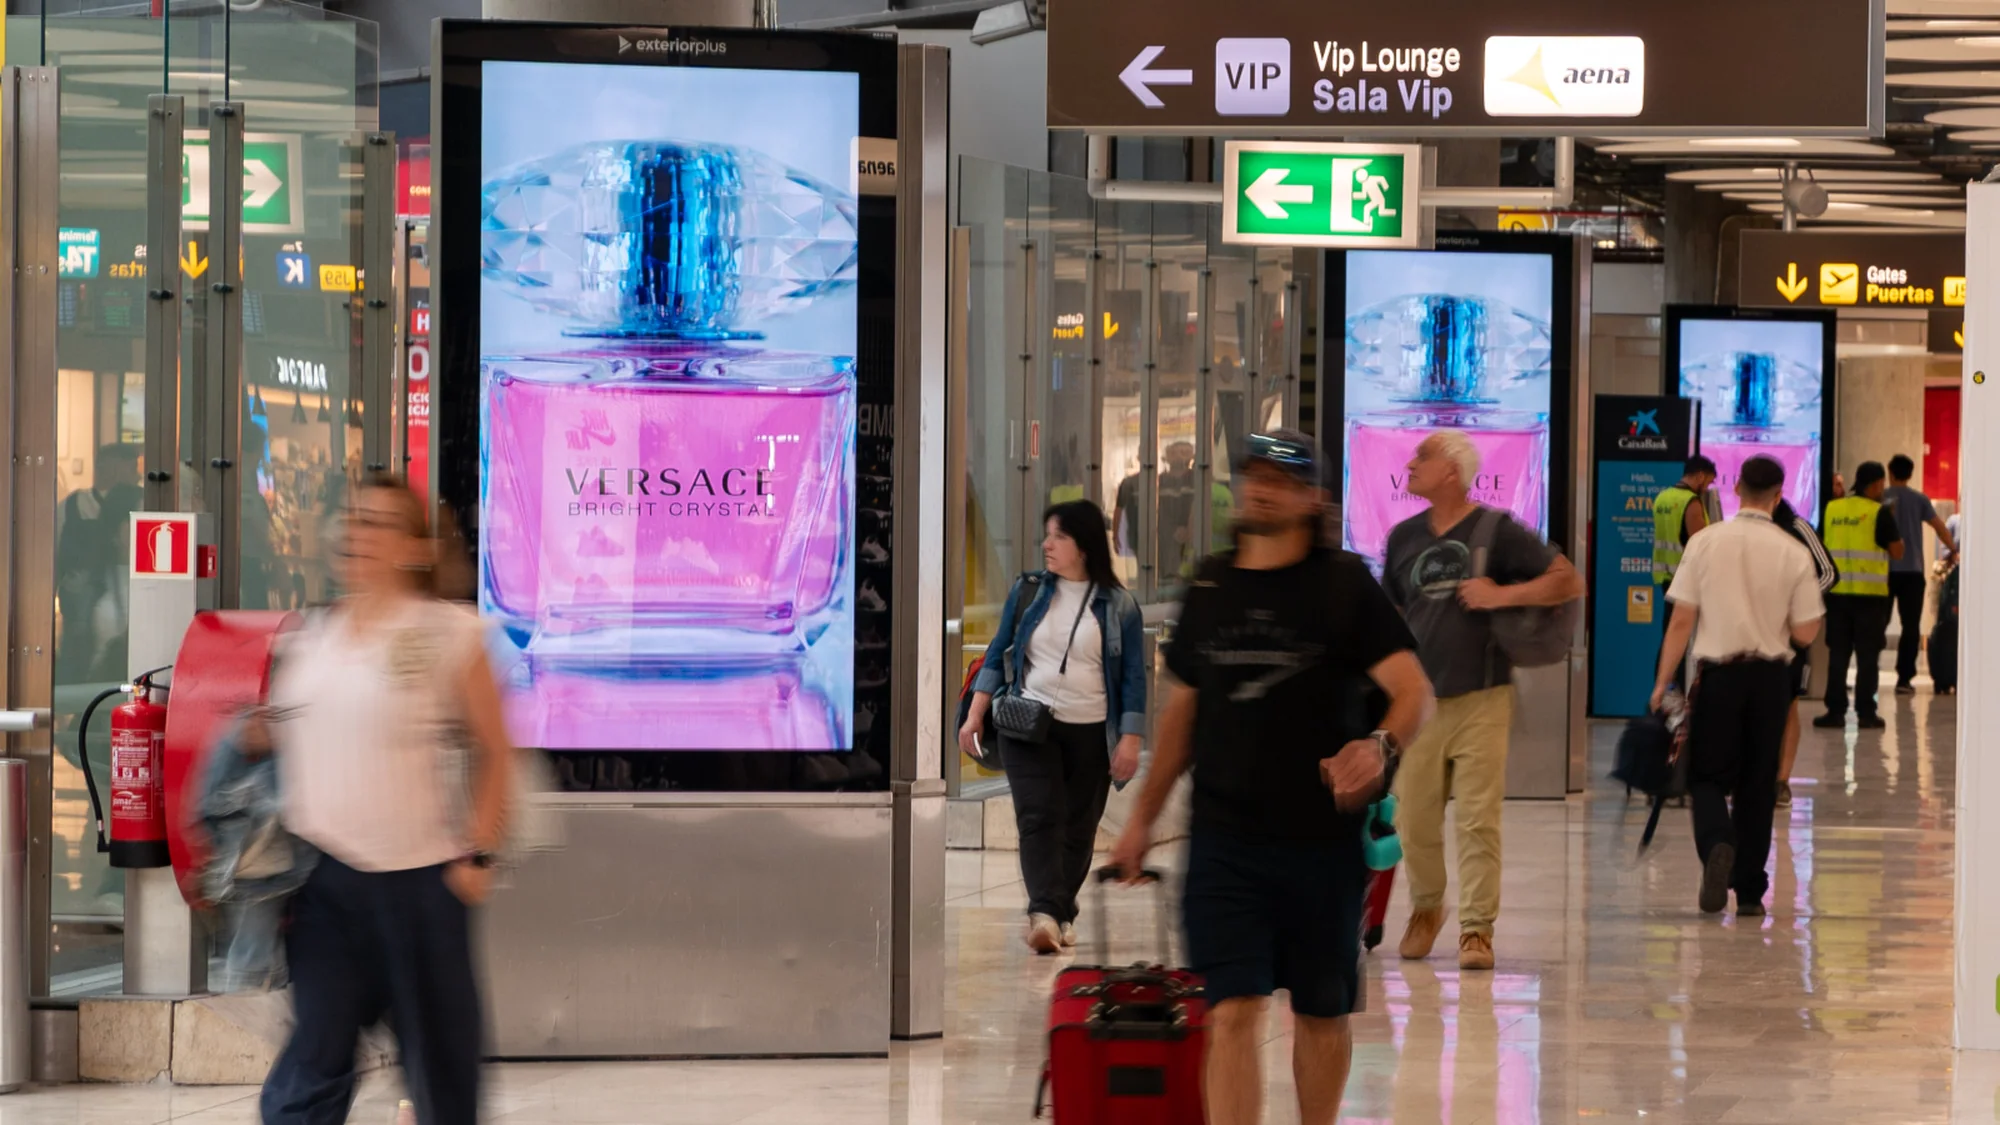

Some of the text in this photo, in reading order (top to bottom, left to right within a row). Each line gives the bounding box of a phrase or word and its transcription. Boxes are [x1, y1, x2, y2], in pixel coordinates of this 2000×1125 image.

[636, 37, 727, 55] exteriorplus
[1313, 41, 1461, 78] Vip Lounge
[1224, 62, 1282, 90] VIP
[1563, 66, 1631, 85] aena
[1313, 79, 1453, 118] Sala Vip
[1867, 265, 1907, 284] Gates
[1866, 284, 1935, 303] Puertas
[1618, 437, 1668, 450] CaixaBank
[565, 468, 775, 496] VERSACE
[1391, 493, 1422, 501] BRIG
[568, 503, 775, 517] BRIGHT CRYSTAL
